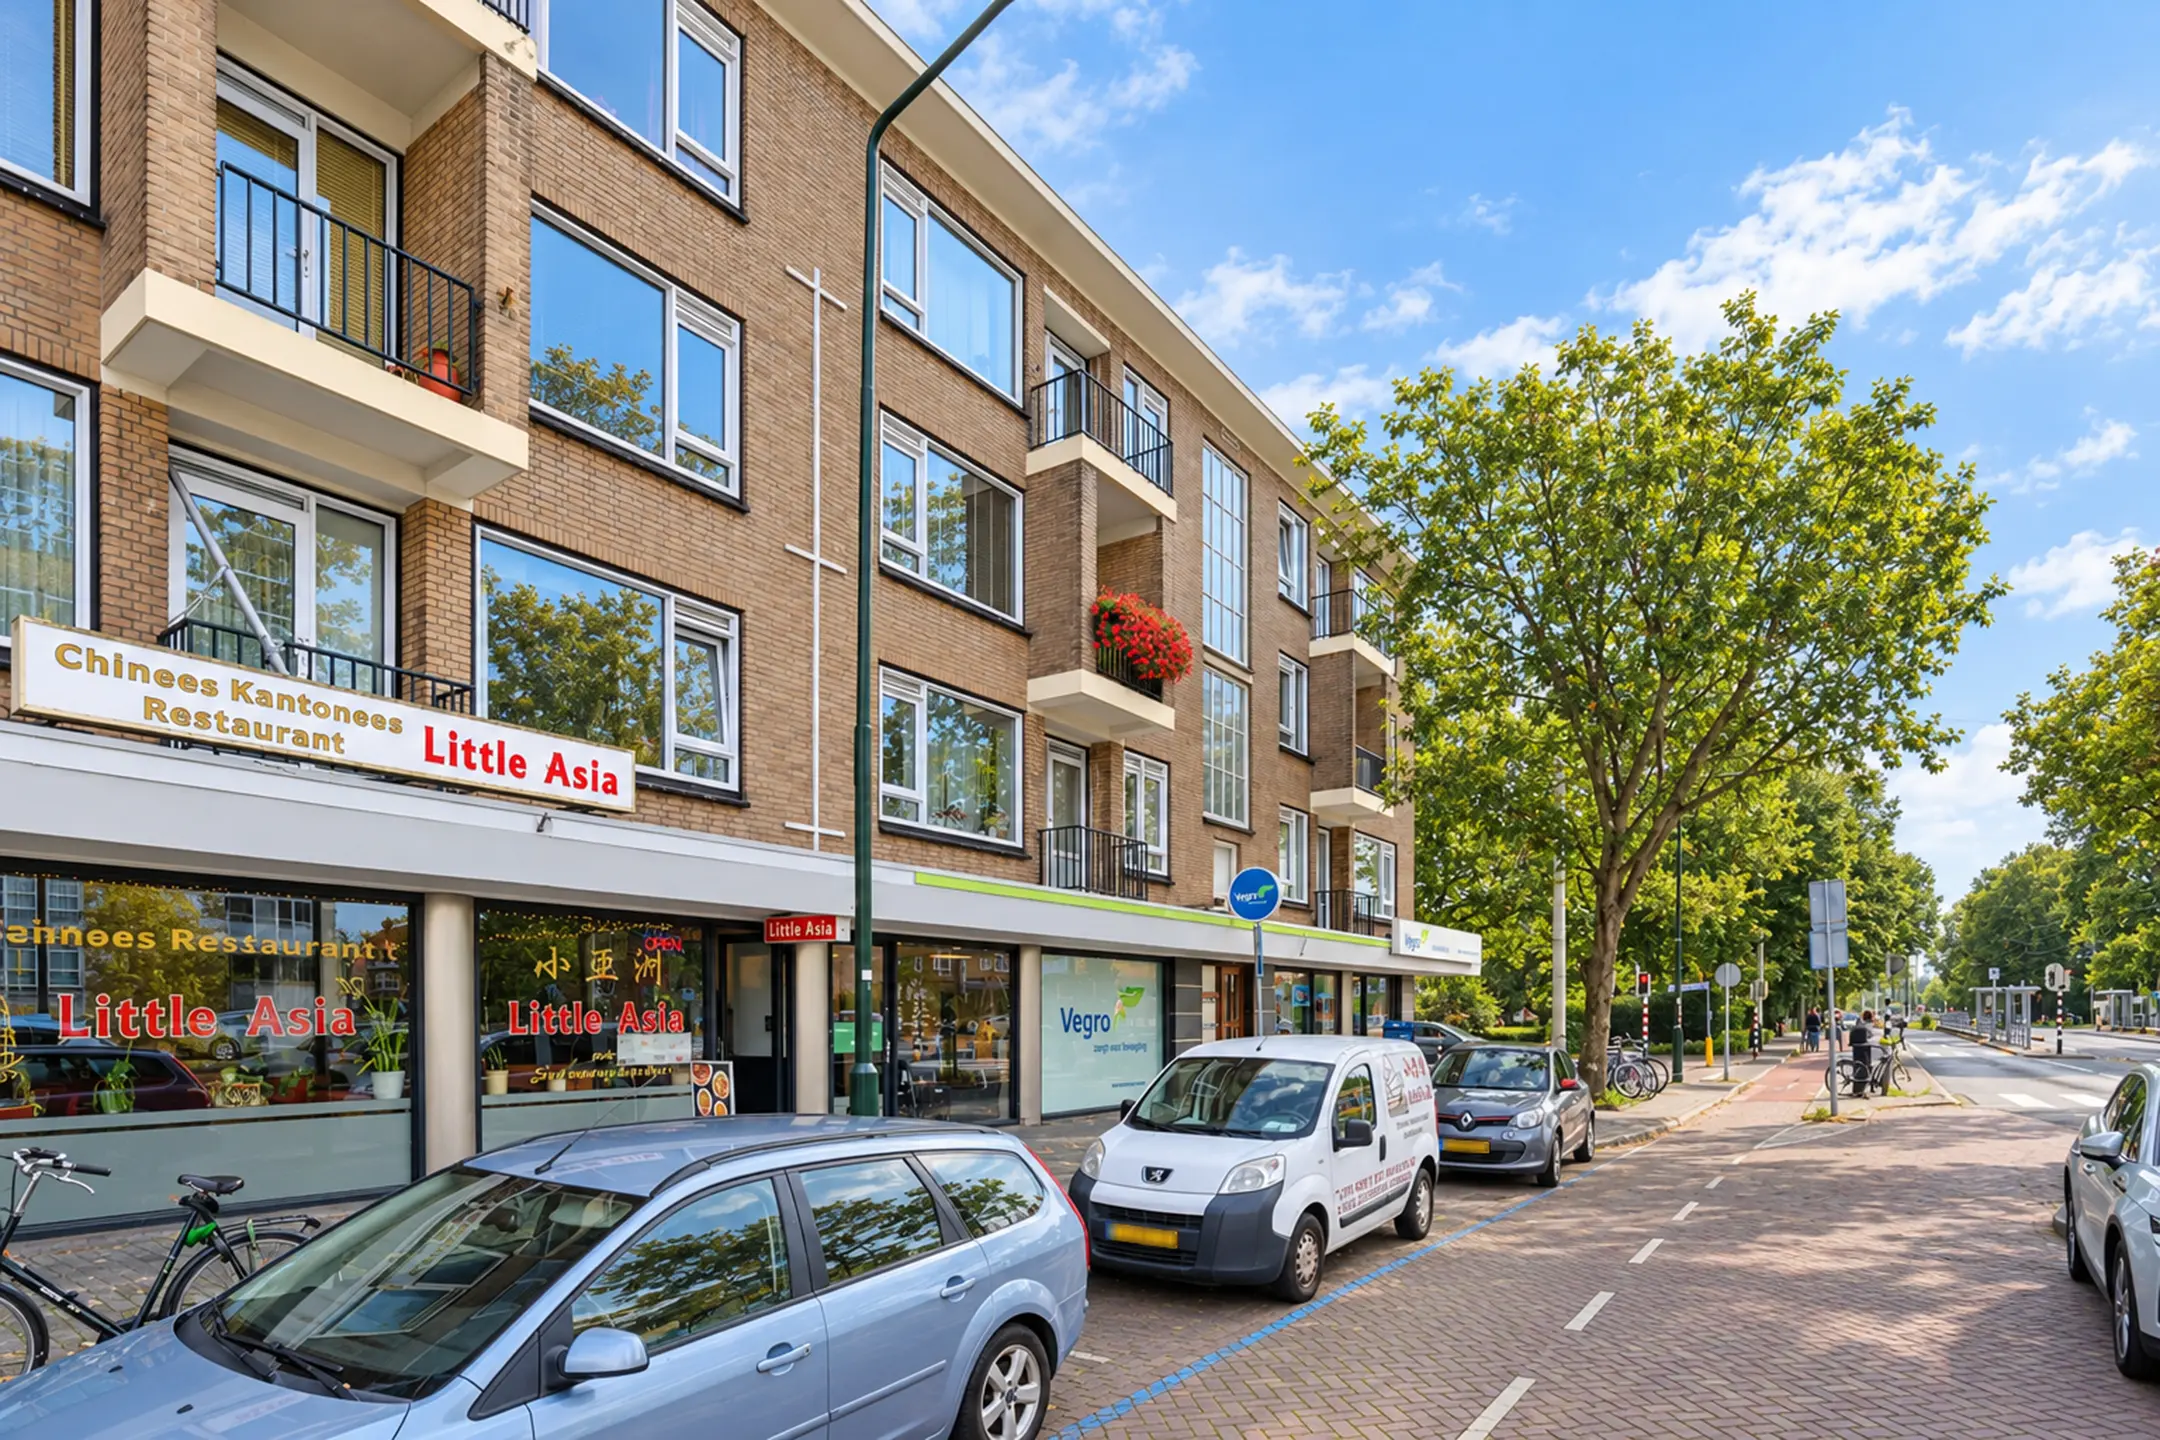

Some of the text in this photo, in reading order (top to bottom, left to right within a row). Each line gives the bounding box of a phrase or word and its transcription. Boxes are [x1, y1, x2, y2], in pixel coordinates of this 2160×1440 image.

[55, 642, 404, 734] Chinees Kantonees
[143, 696, 346, 755] Restaurant
[424, 725, 619, 796] Little Asia
[769, 919, 833, 938] Little Asia
[57, 993, 357, 1040] Little Asia
[508, 999, 685, 1036] Little Asia
[1060, 1007, 1111, 1040] Vegro
